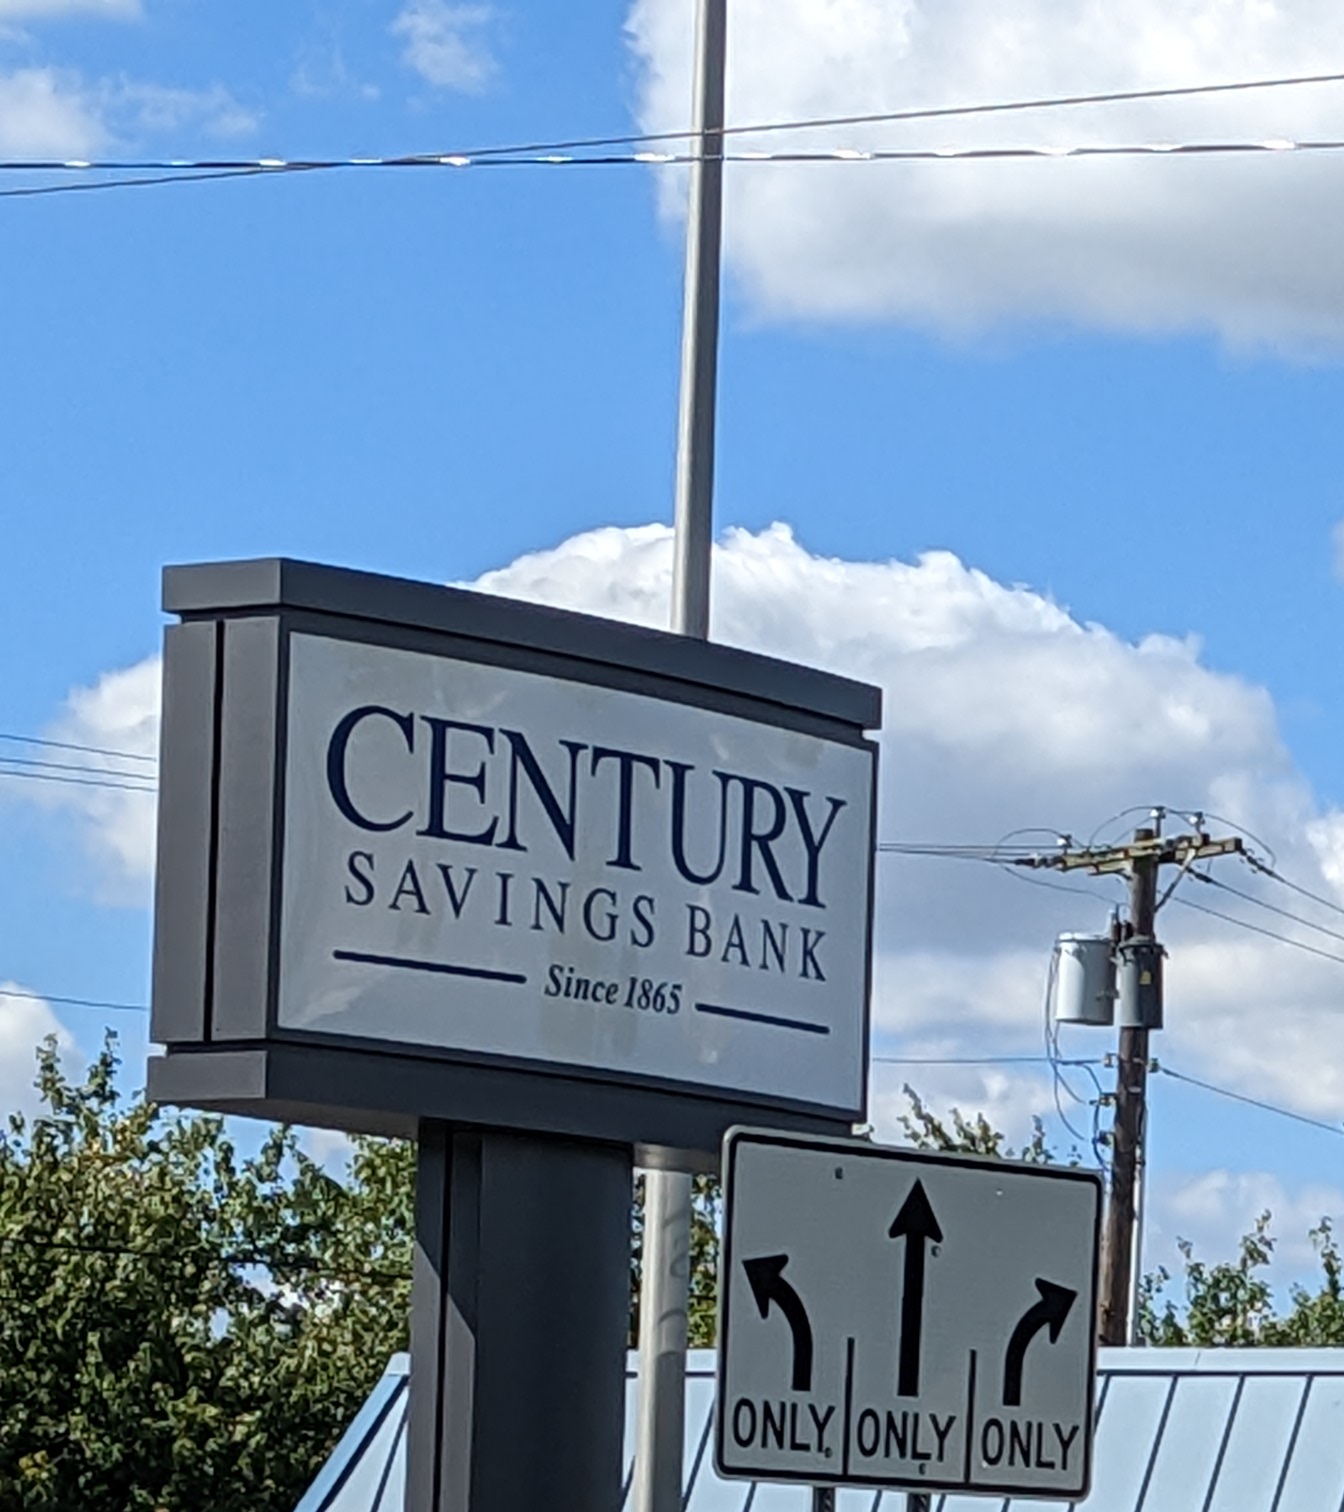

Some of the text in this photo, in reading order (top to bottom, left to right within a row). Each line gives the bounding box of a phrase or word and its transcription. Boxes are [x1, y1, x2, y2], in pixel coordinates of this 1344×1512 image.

[326, 704, 848, 909] CENTURY
[345, 850, 827, 983] SAVINGS BANK
[544, 963, 684, 1015] Since 1865
[732, 1397, 835, 1454] ONLY
[857, 1408, 956, 1462] ONLY
[981, 1417, 1080, 1471] ONLY
